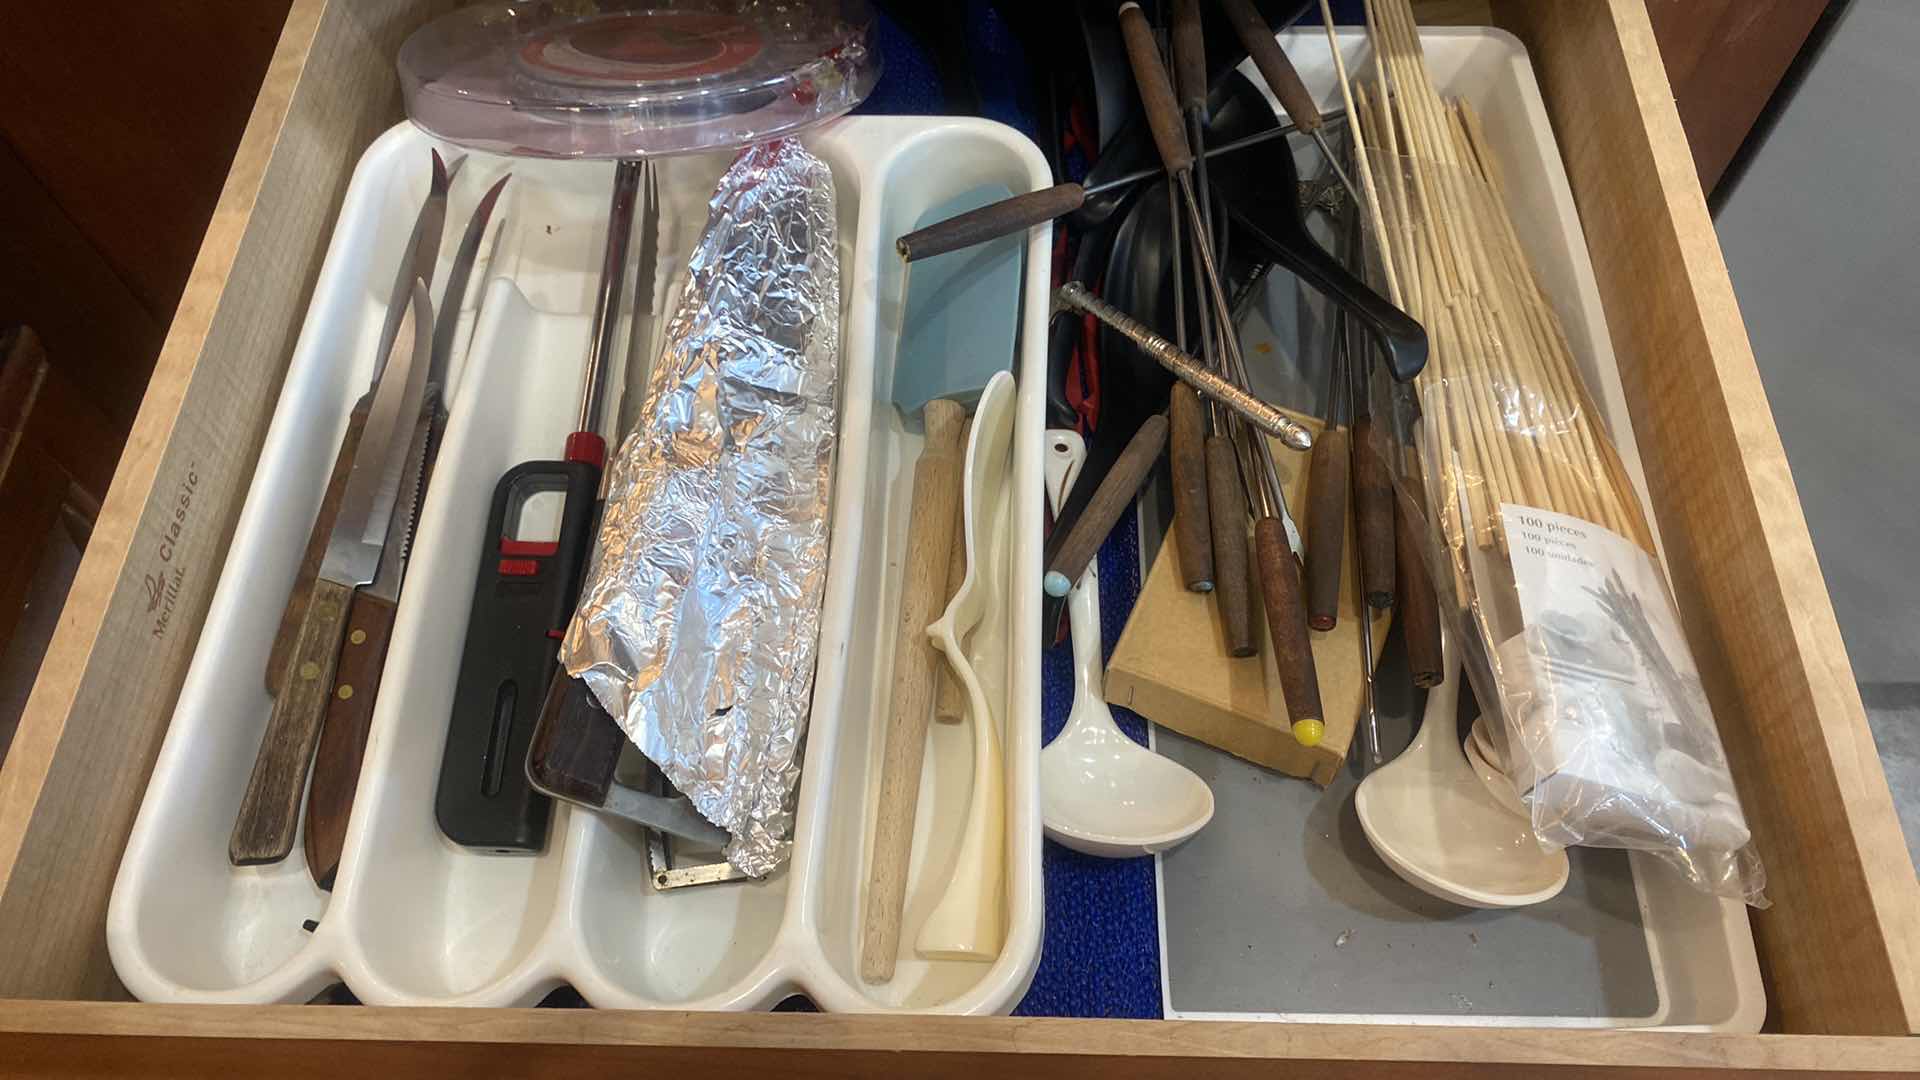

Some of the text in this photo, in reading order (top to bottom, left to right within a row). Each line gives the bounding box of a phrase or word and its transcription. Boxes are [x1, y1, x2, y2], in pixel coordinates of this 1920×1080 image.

[1519, 515, 1588, 539] 100 pieces
[1522, 531, 1542, 543] 100
[1525, 545, 1545, 558] 100
